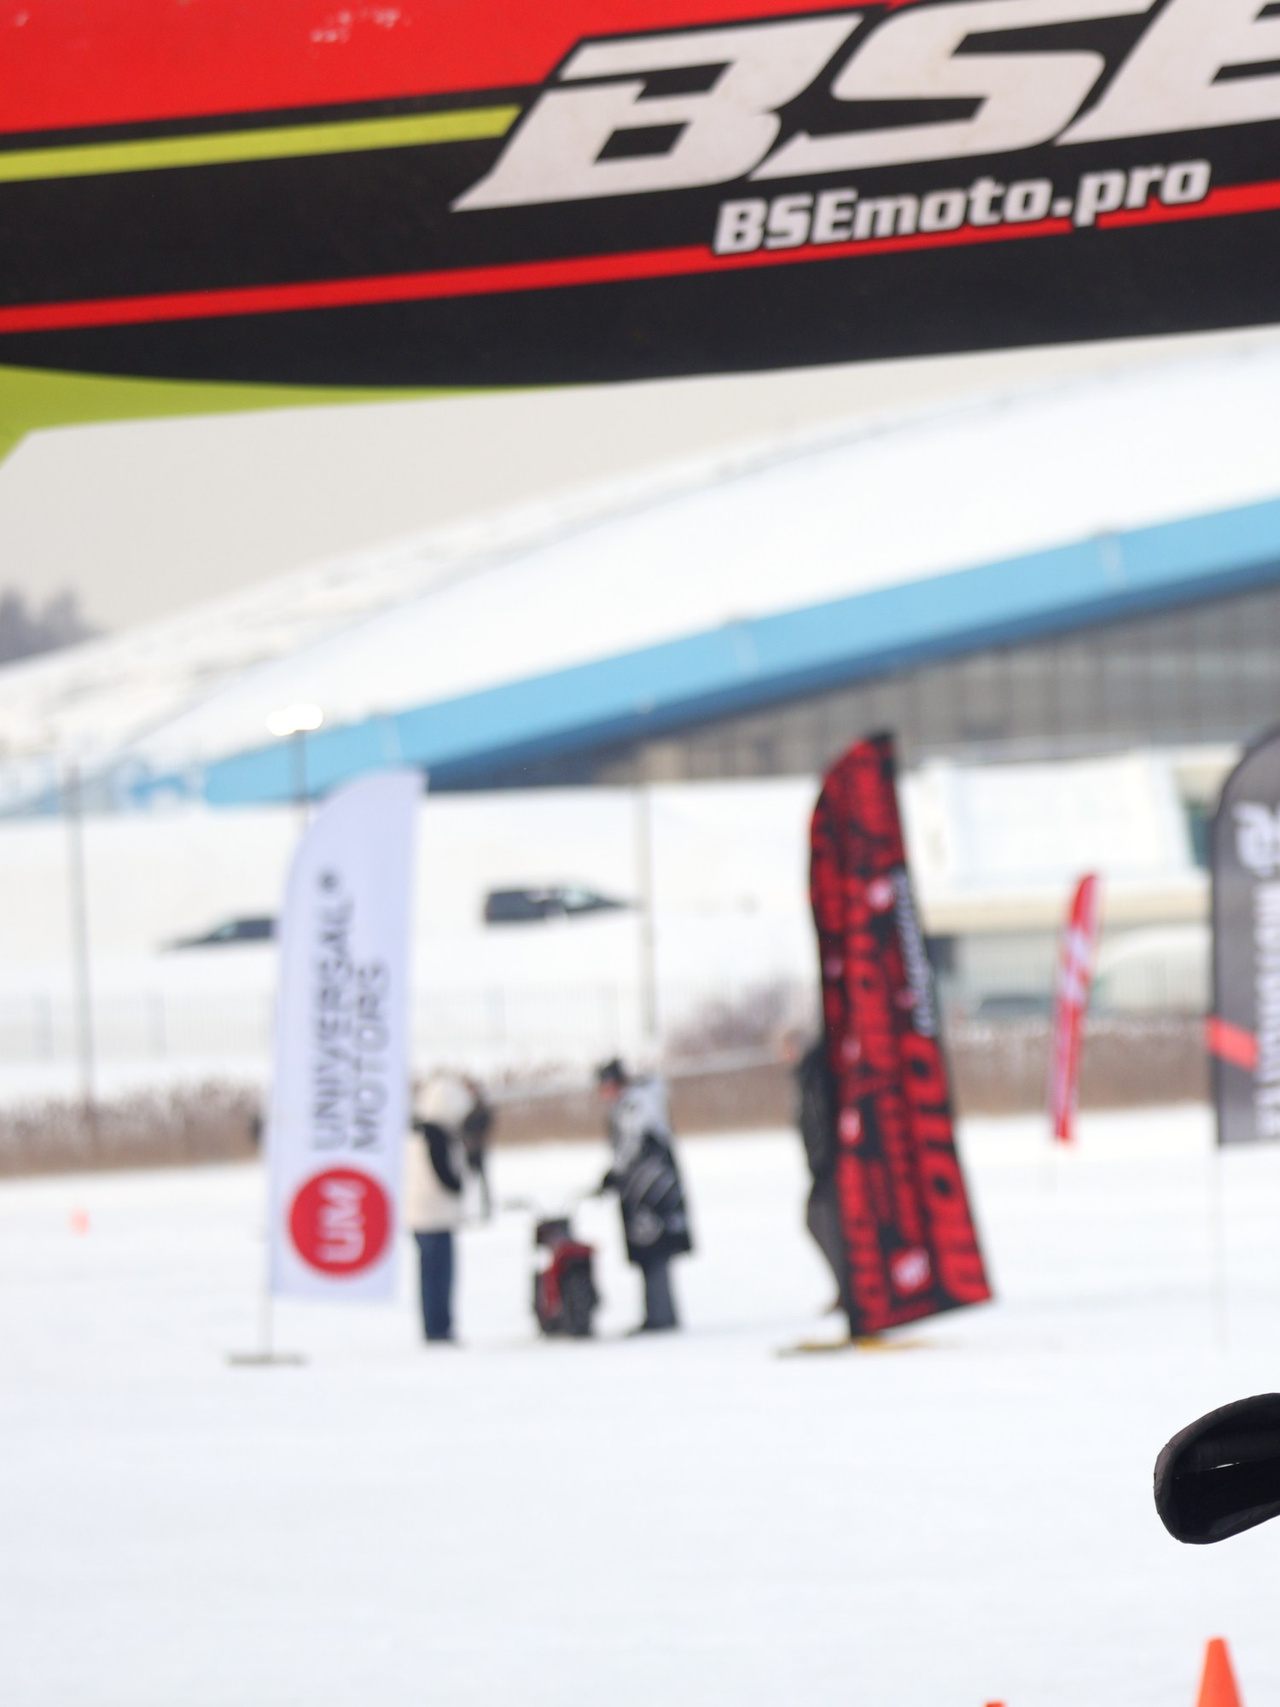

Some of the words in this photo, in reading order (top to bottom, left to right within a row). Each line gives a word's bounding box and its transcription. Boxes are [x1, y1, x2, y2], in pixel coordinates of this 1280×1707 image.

[713, 159, 1212, 256] BSEmoto.pro
[312, 898, 355, 1153] UNIVERSAL
[350, 956, 391, 1153] MOTORS
[316, 1177, 367, 1263] UM
